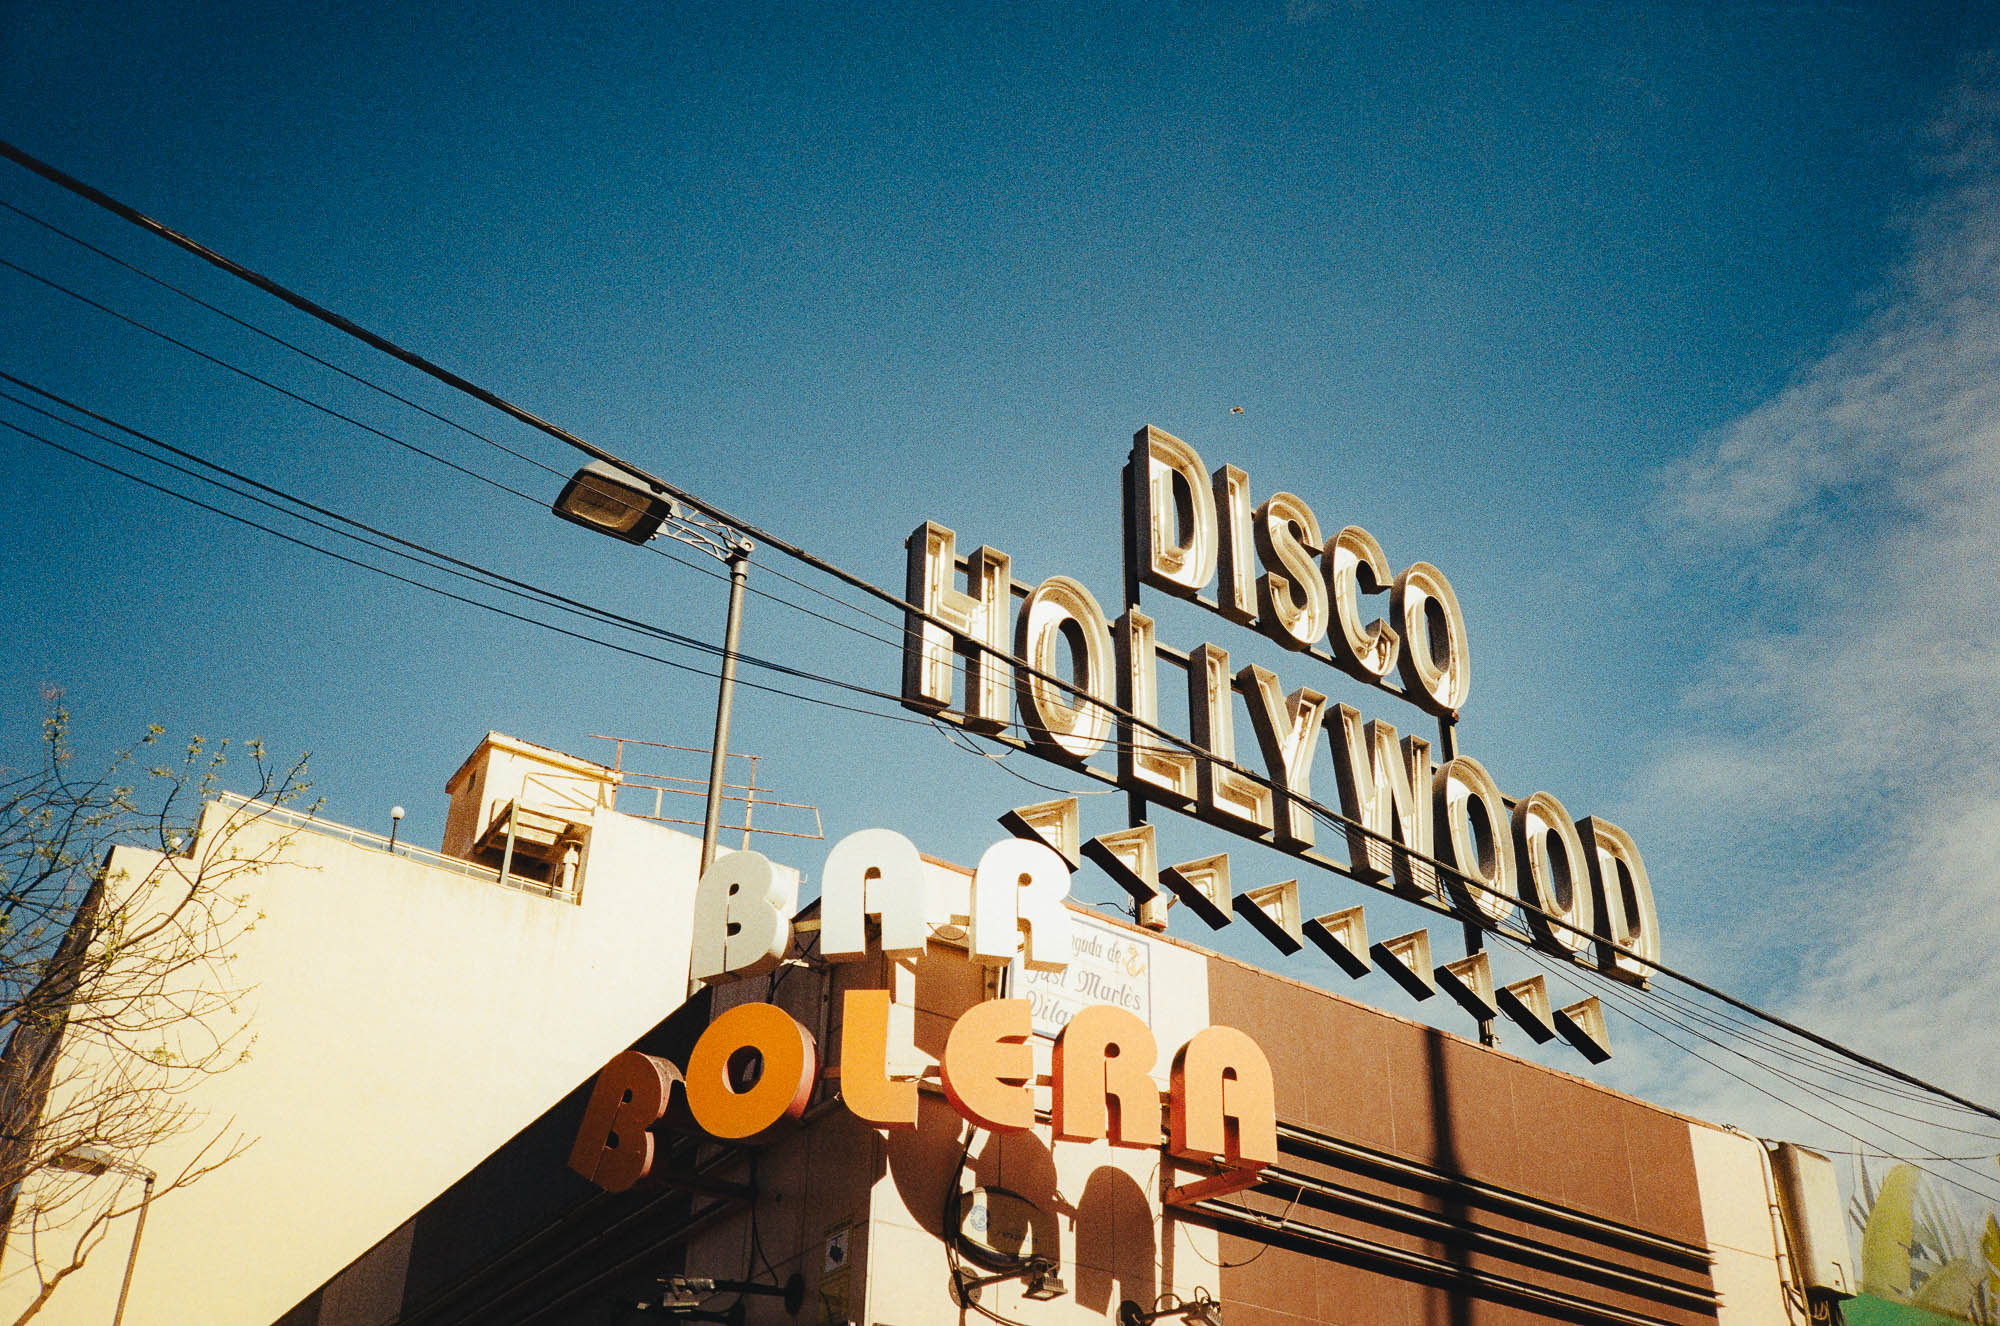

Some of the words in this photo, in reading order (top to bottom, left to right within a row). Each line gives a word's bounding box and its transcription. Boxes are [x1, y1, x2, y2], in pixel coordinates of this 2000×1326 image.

[1124, 424, 1471, 714] DISCO
[902, 520, 1661, 986] HOLLYWOOD
[690, 829, 1073, 983] BAR
[1107, 940, 1121, 962] de
[568, 989, 1278, 1194] BOLERA
